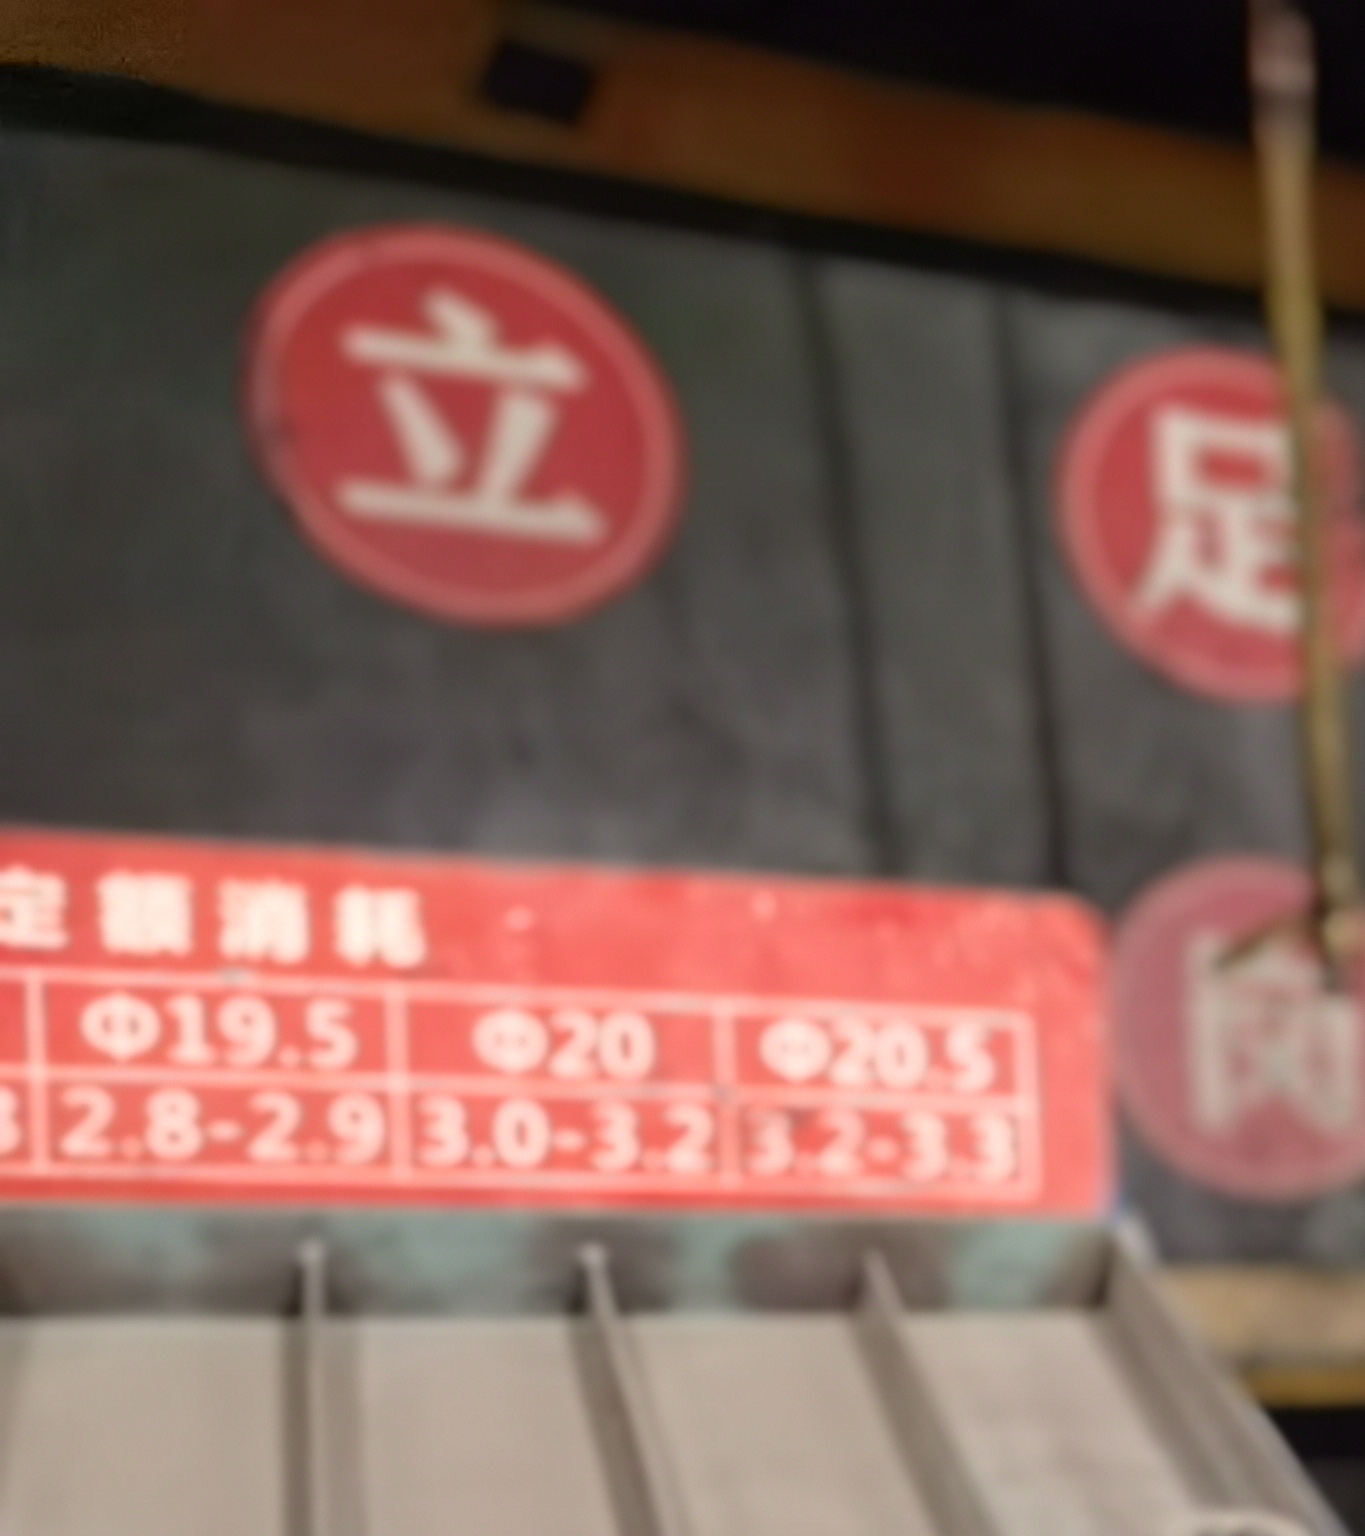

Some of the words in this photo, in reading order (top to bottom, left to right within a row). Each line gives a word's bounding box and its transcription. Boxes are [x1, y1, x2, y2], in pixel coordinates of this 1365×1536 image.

[336, 284, 605, 544] 立
[1128, 402, 1303, 634] 足
[60, 1086, 386, 1166] 2.8-2.9
[419, 1096, 717, 1174] 3.0-3.2
[747, 1107, 1016, 1181] 3.2-3.3
